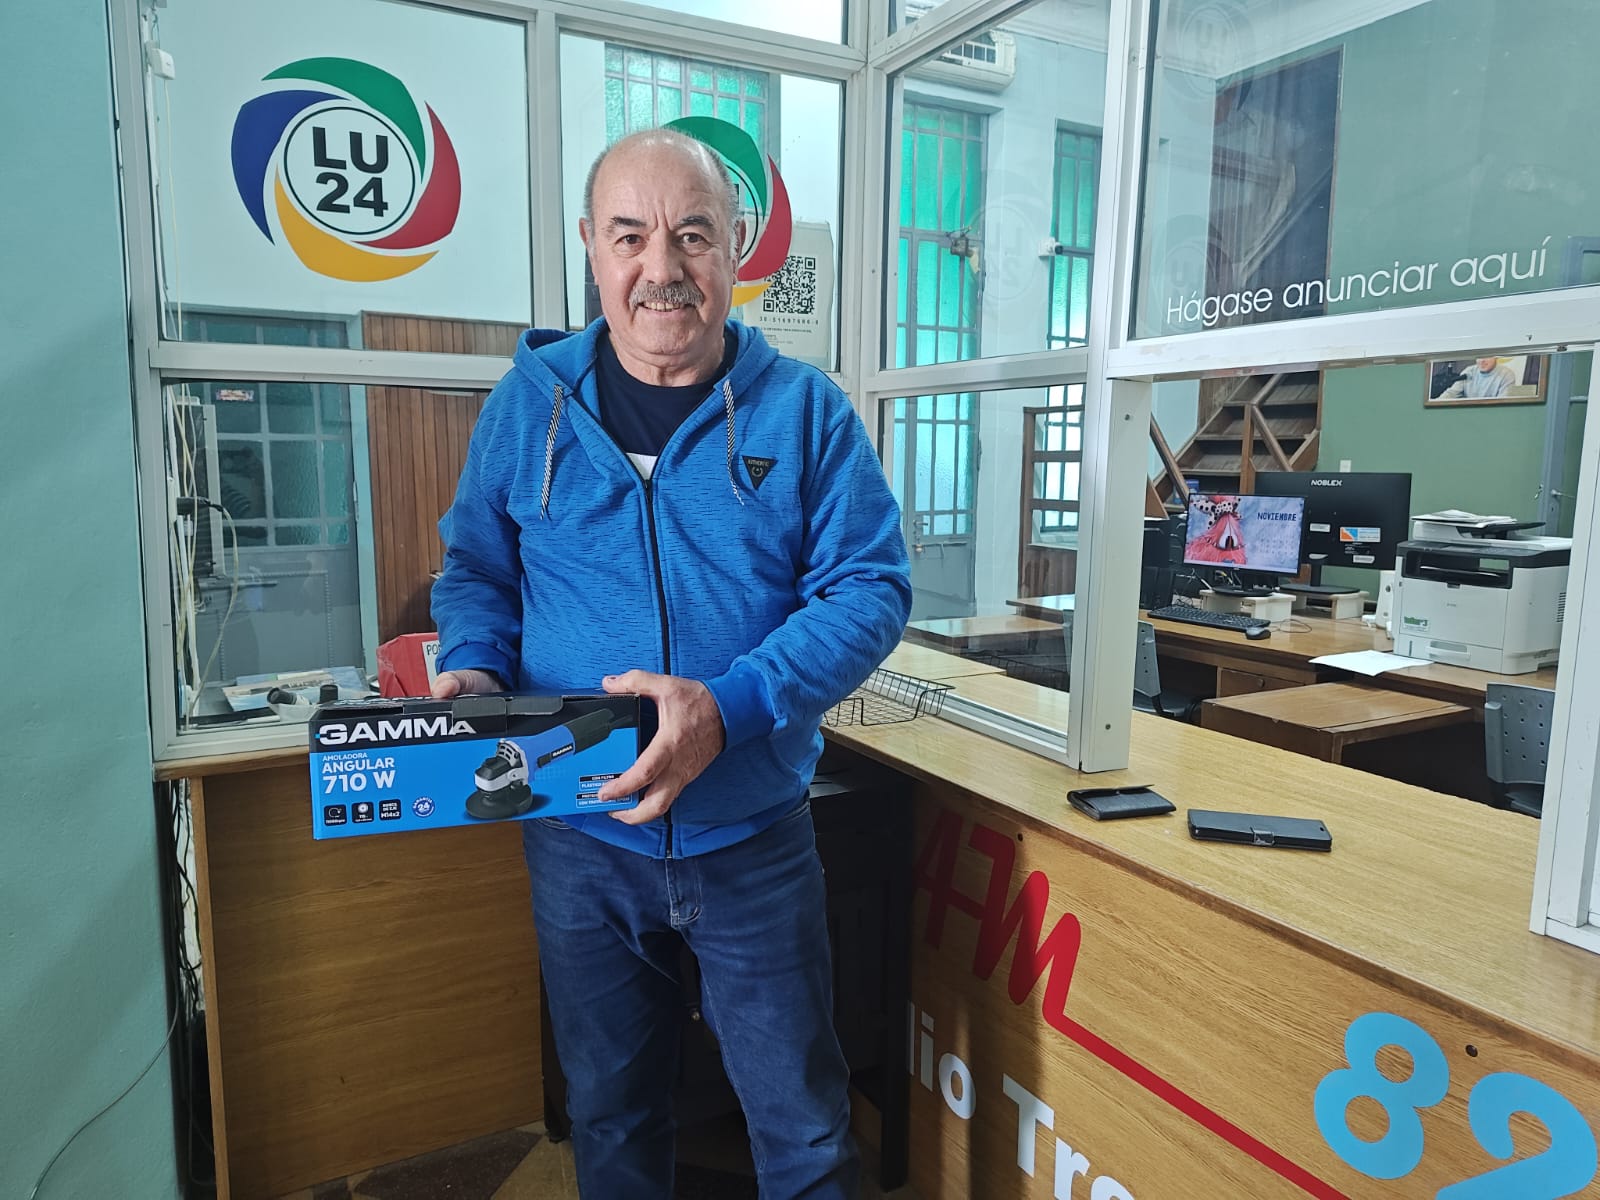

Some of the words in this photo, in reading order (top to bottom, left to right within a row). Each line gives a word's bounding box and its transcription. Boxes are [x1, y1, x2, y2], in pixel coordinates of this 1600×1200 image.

[312, 126, 389, 174] LU
[315, 171, 389, 217] 24
[1166, 285, 1273, 326] Hágase
[1282, 261, 1438, 307] anunciar
[1449, 235, 1552, 288] aquí
[1311, 479, 1343, 487] NOBLEX
[1257, 512, 1297, 521] NOVIEMBRE
[318, 716, 477, 745] GAMMA
[322, 752, 368, 762] AMOLADORA
[322, 757, 395, 774] ANGULAR
[322, 773, 367, 794] 710
[373, 770, 396, 789] W
[1314, 1011, 1598, 1200] 82
